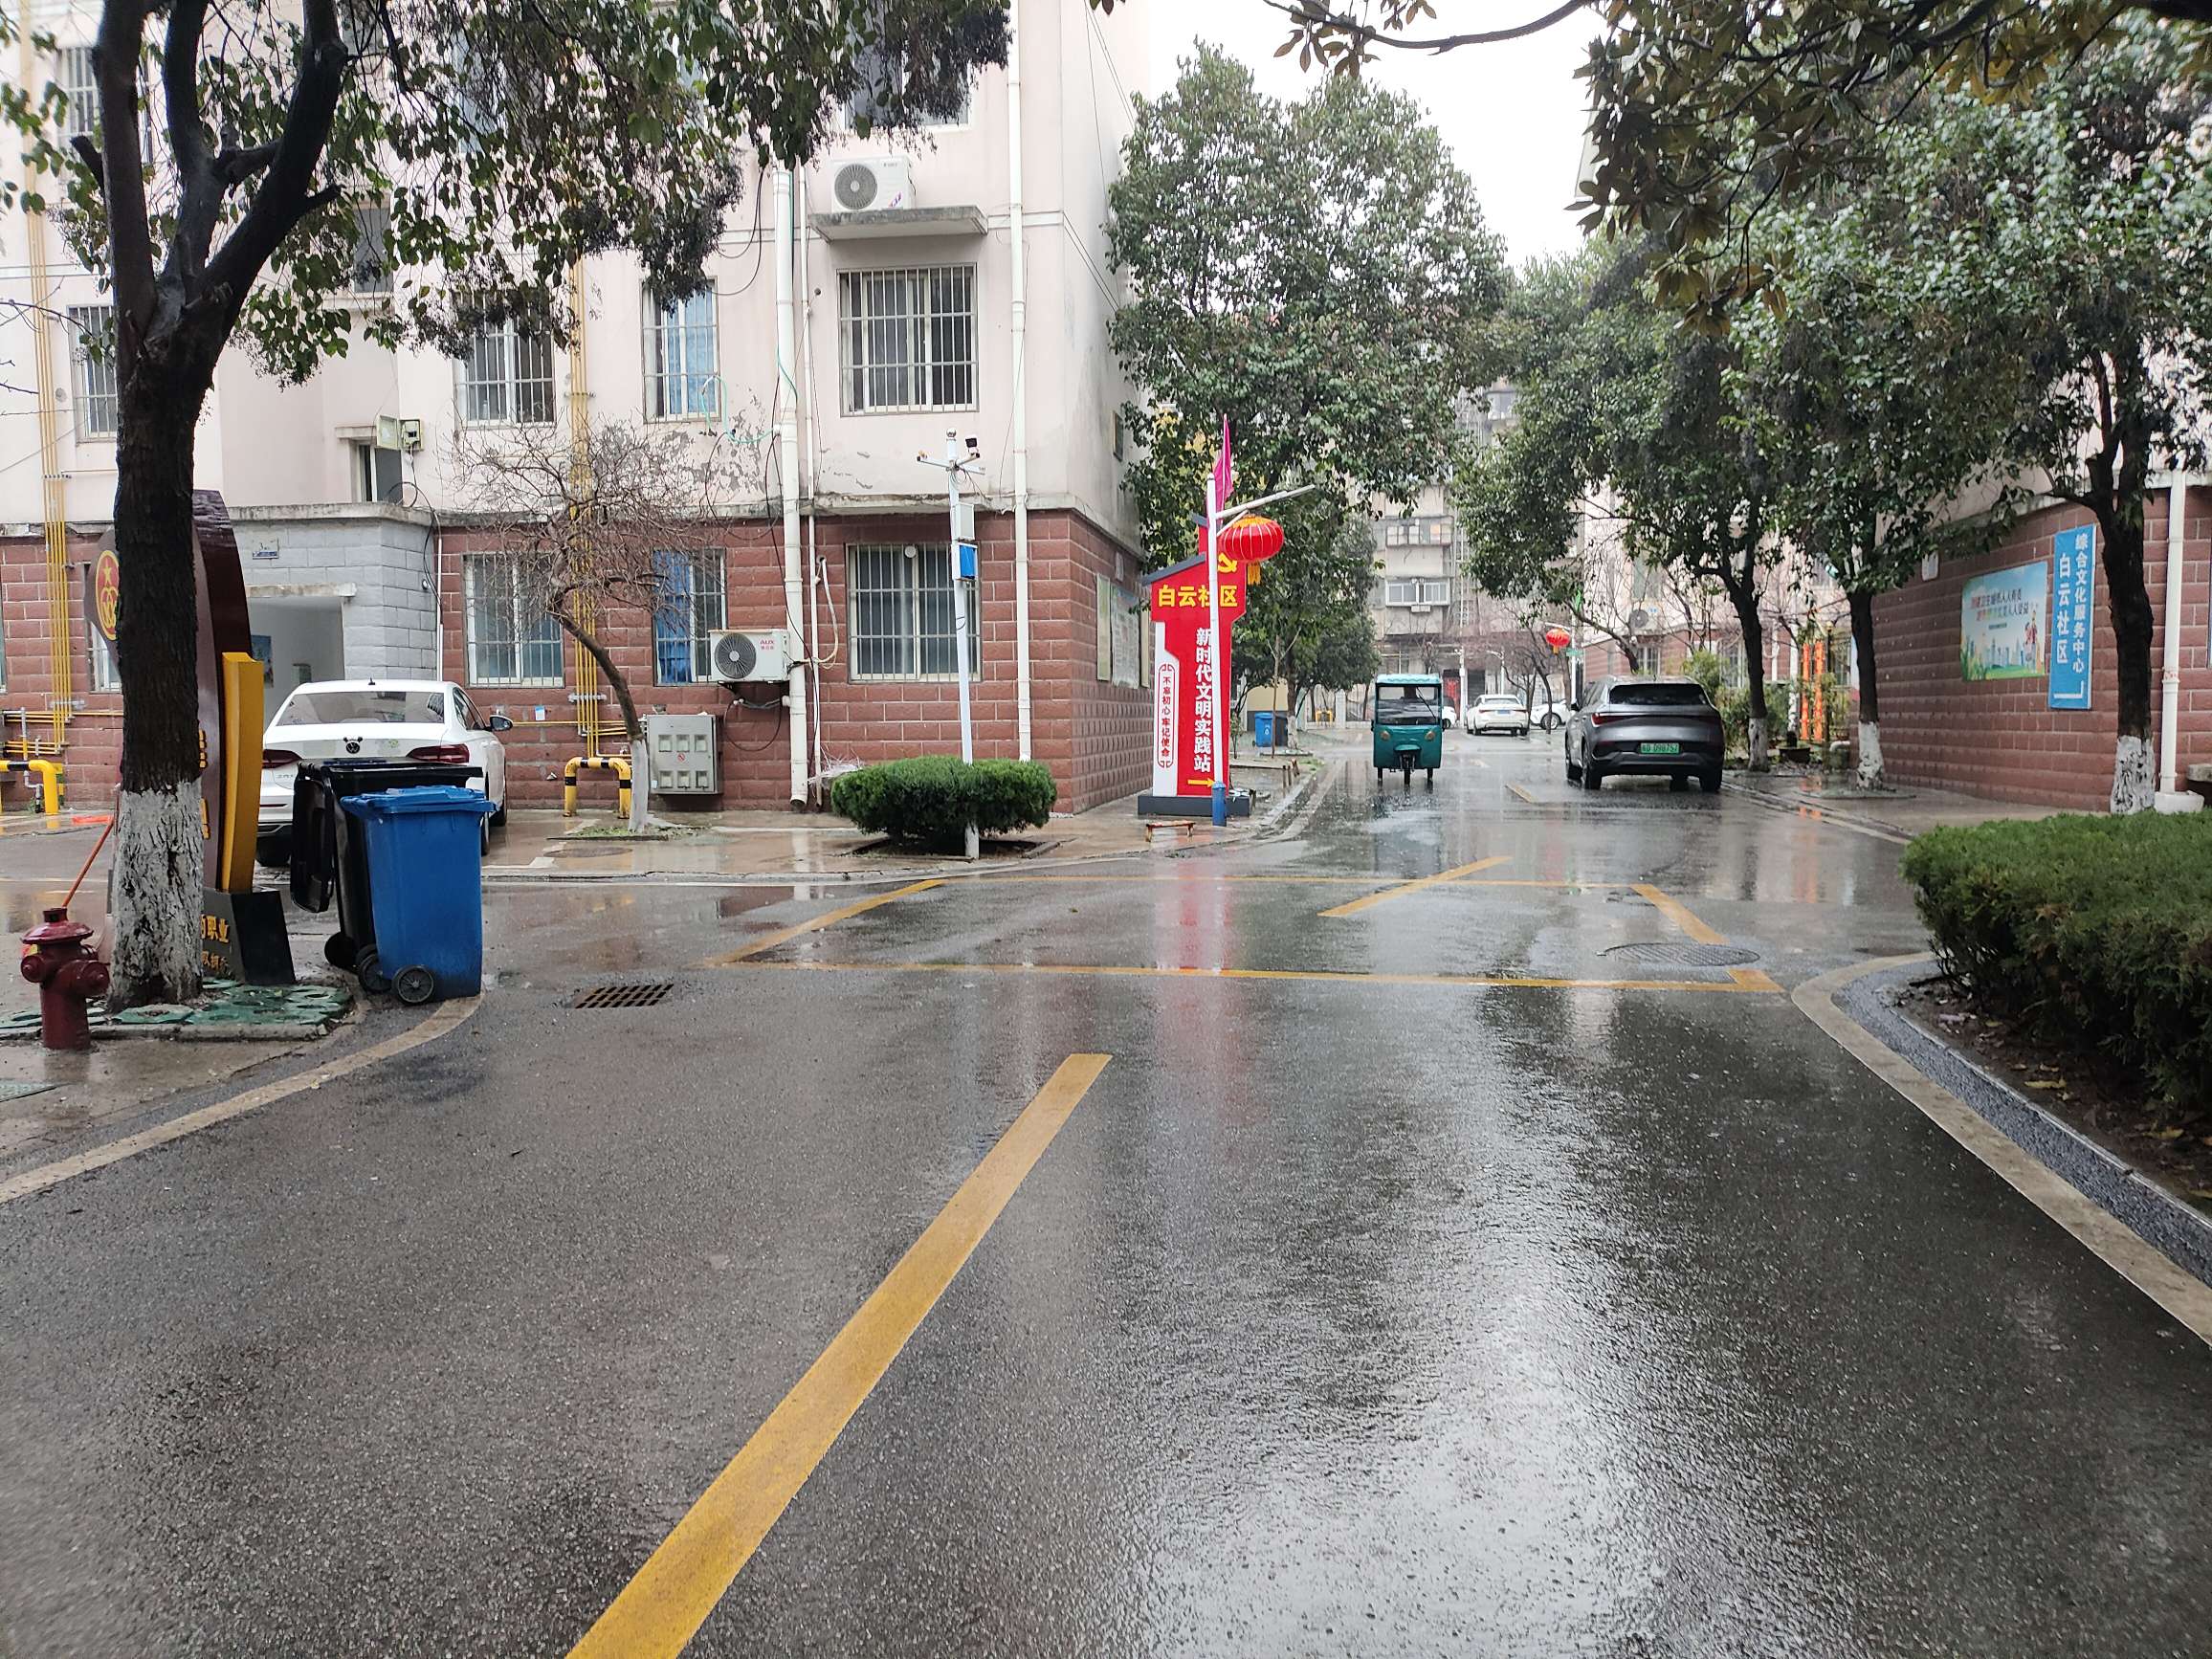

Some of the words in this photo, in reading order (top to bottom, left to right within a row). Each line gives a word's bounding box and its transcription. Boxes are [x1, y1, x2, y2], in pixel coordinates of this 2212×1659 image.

[1158, 584, 1238, 608] 白云社区
[2056, 554, 2070, 664] 白云社区
[2073, 533, 2088, 673] 综合文化服务中心
[1194, 627, 1213, 773] 新时代文明实践站
